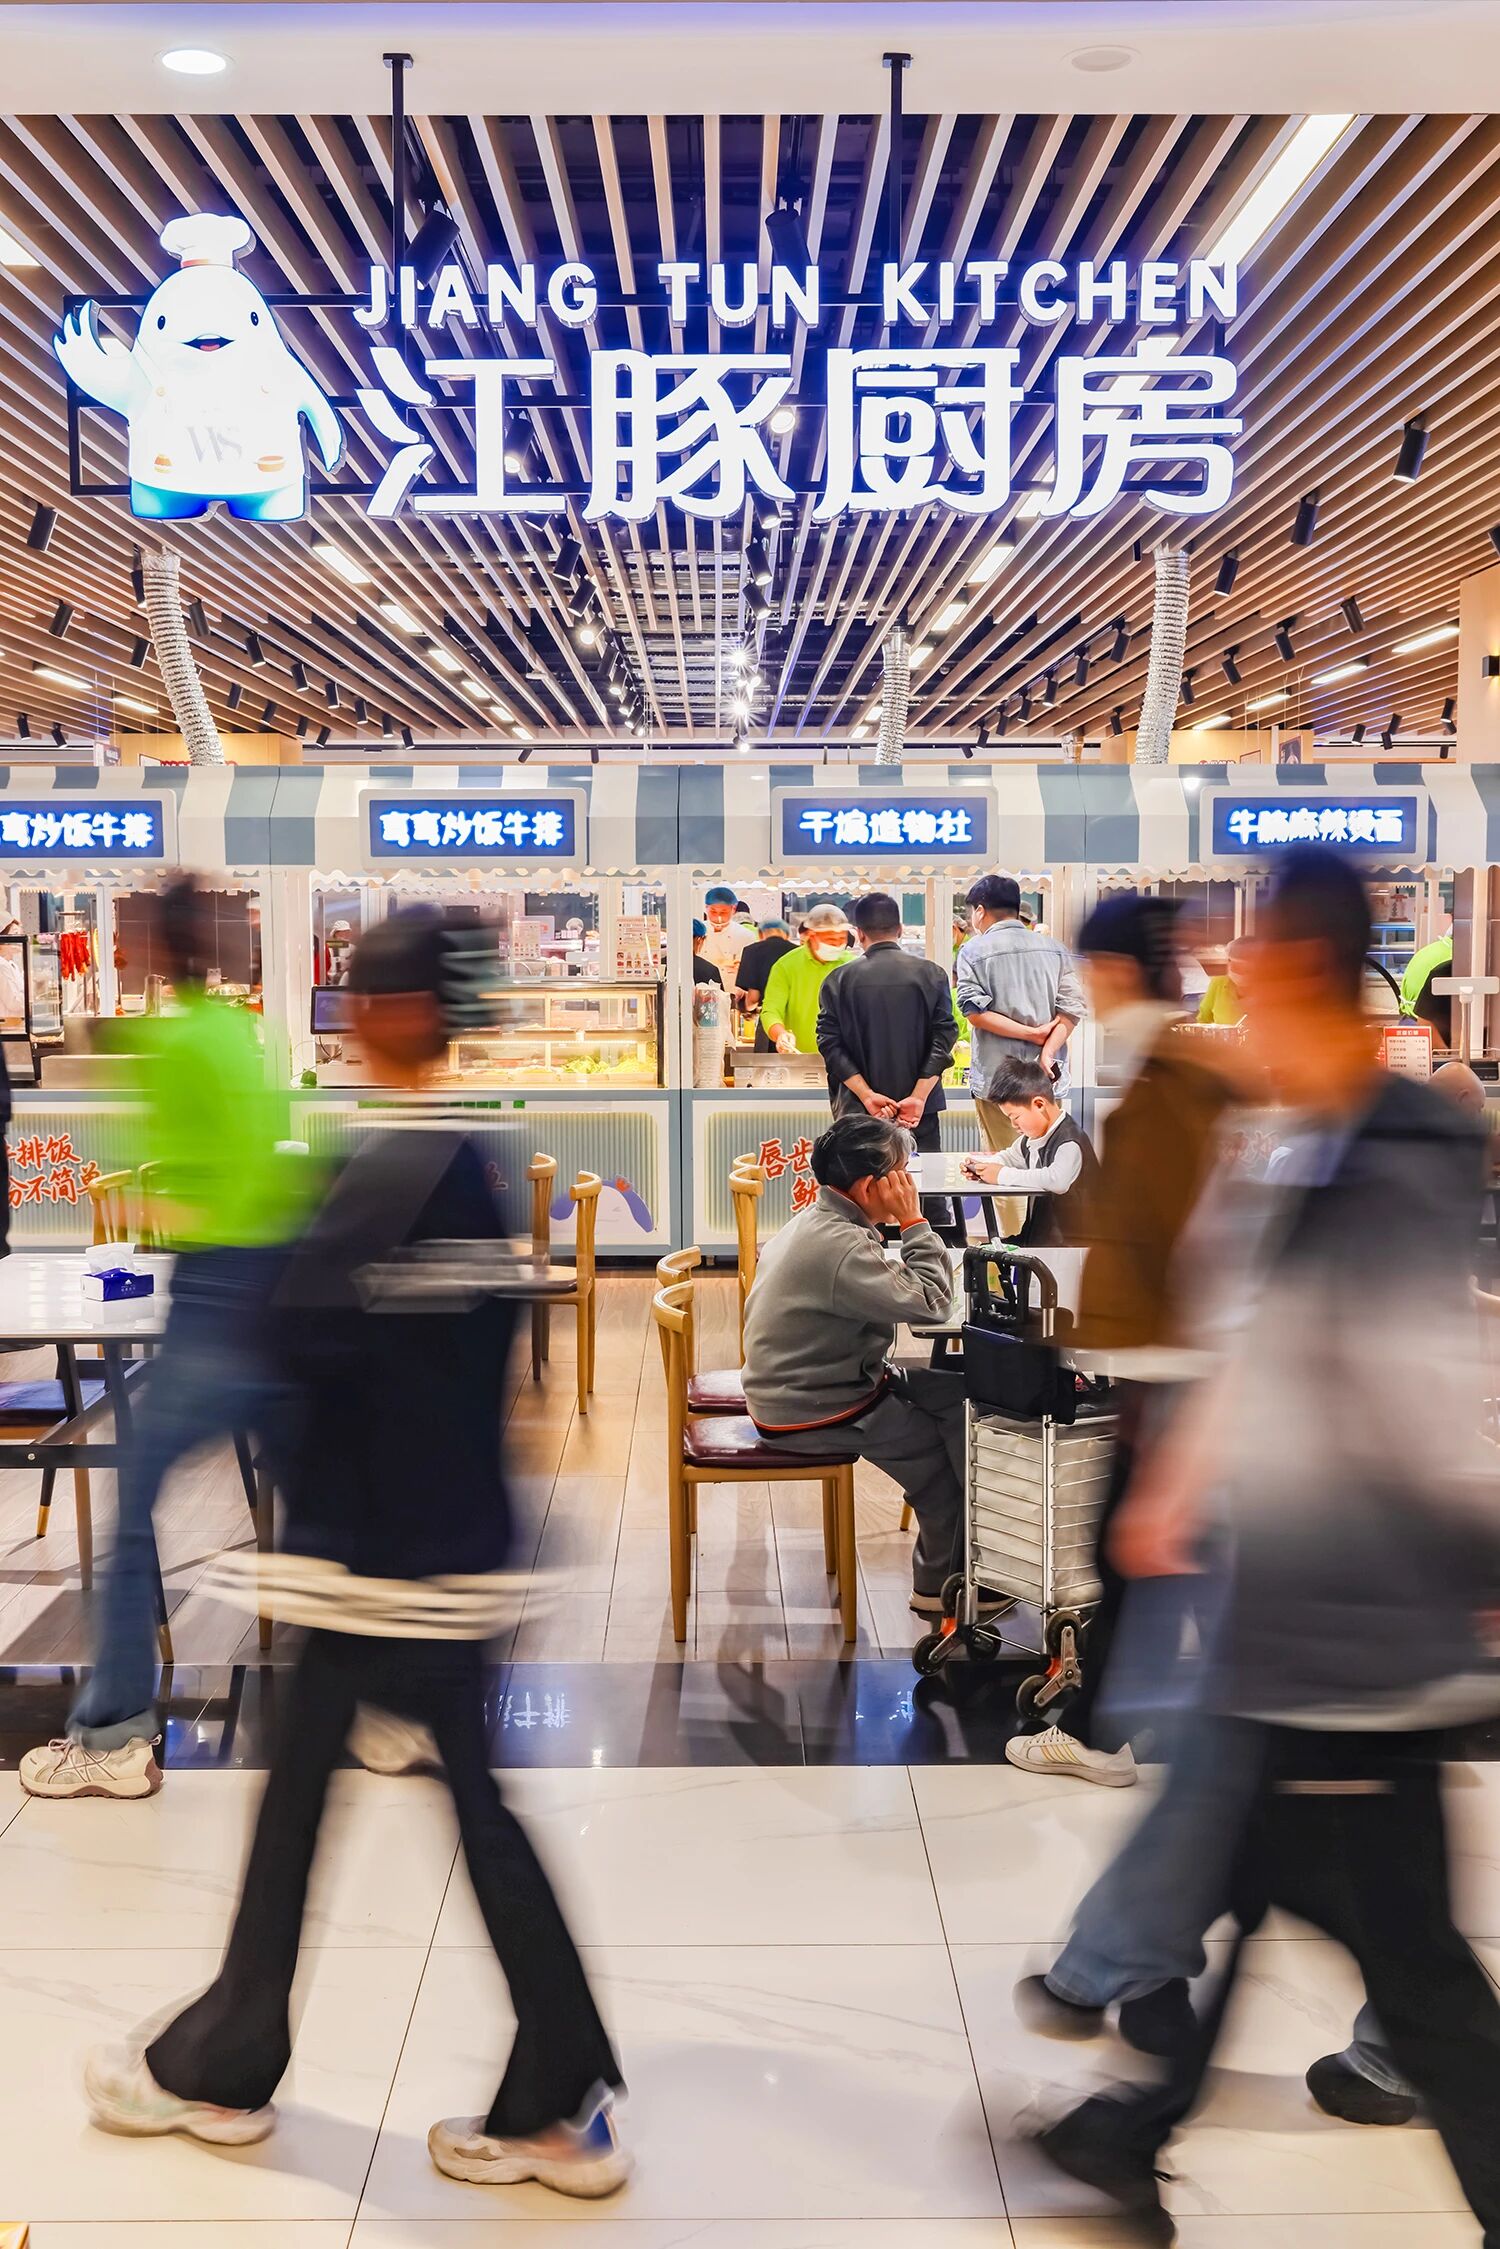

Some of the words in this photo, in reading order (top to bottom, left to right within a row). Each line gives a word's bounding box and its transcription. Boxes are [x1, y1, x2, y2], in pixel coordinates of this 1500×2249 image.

[353, 264, 598, 328] JIANG
[658, 263, 820, 327] TUN
[882, 259, 1239, 326] KITCHEN
[355, 339, 1243, 521] 江豚厨房
